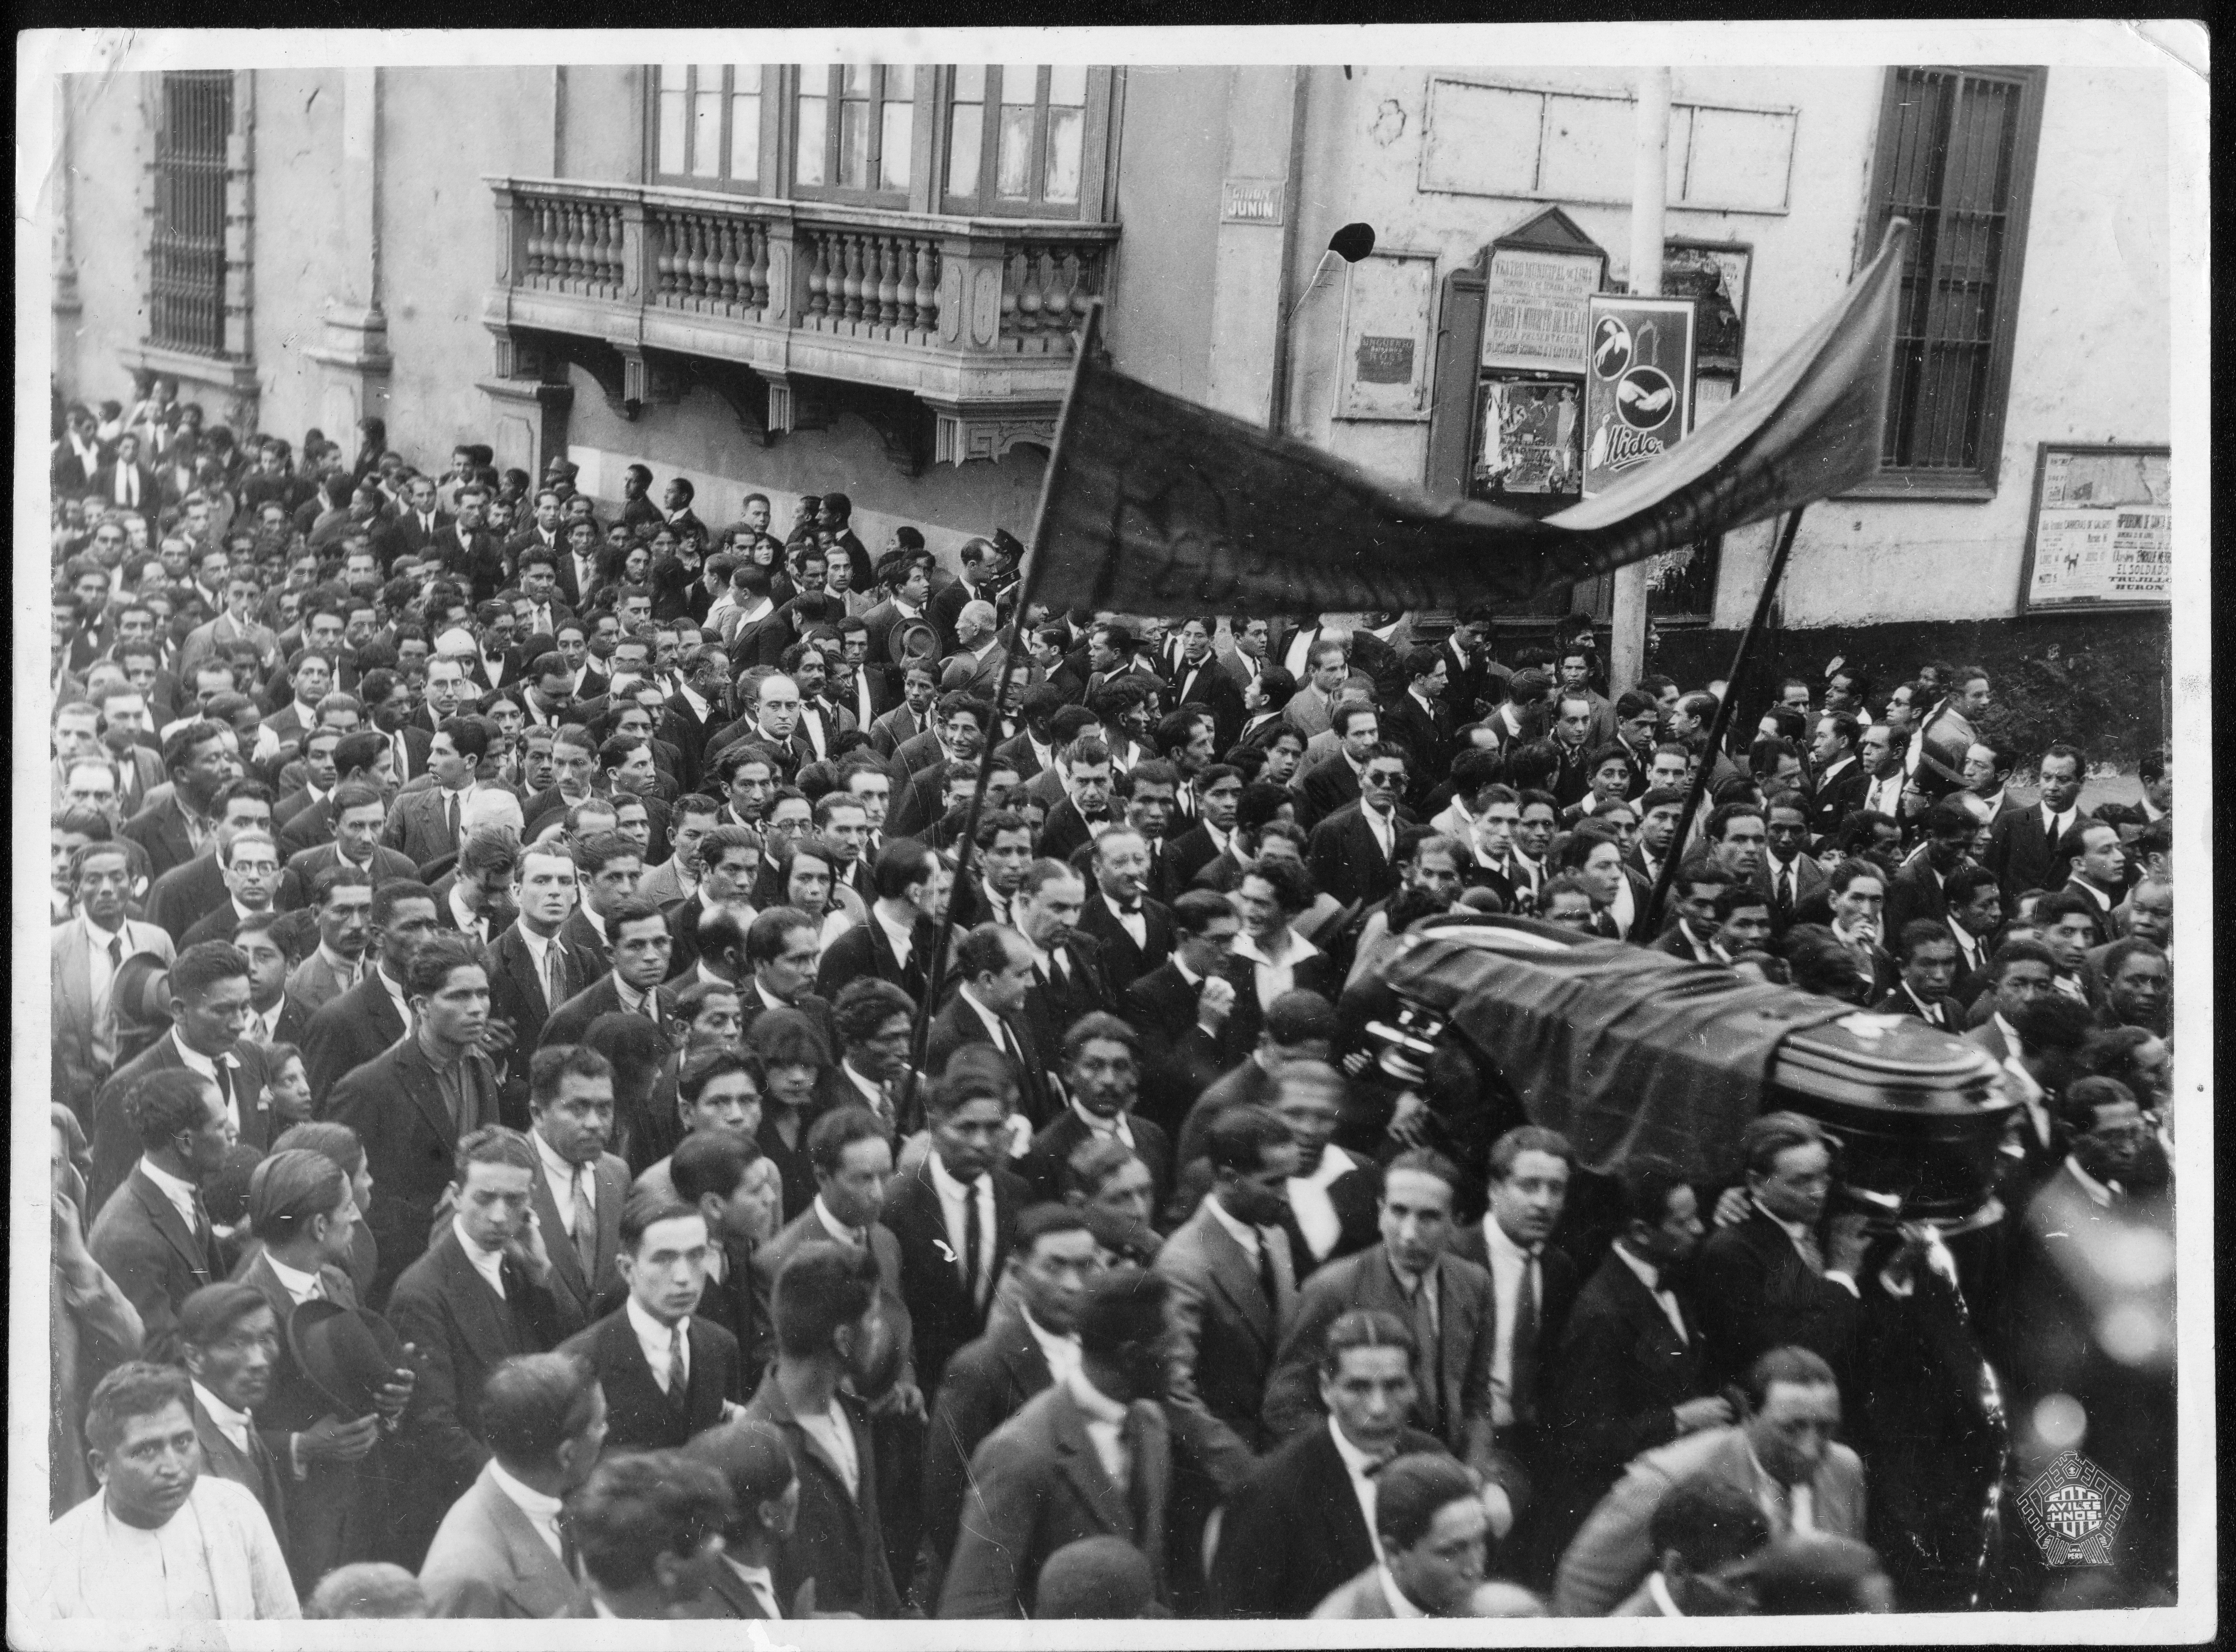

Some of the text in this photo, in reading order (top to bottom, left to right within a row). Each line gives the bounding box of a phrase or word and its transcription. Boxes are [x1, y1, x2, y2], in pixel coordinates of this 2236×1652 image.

[1228, 201, 1273, 218] JUNIN
[1495, 259, 1524, 276] TEATRO
[1525, 262, 1564, 281] MUNICIPAL
[1521, 332, 1580, 344] PRESENTACION
[2117, 564, 2126, 575] EL
